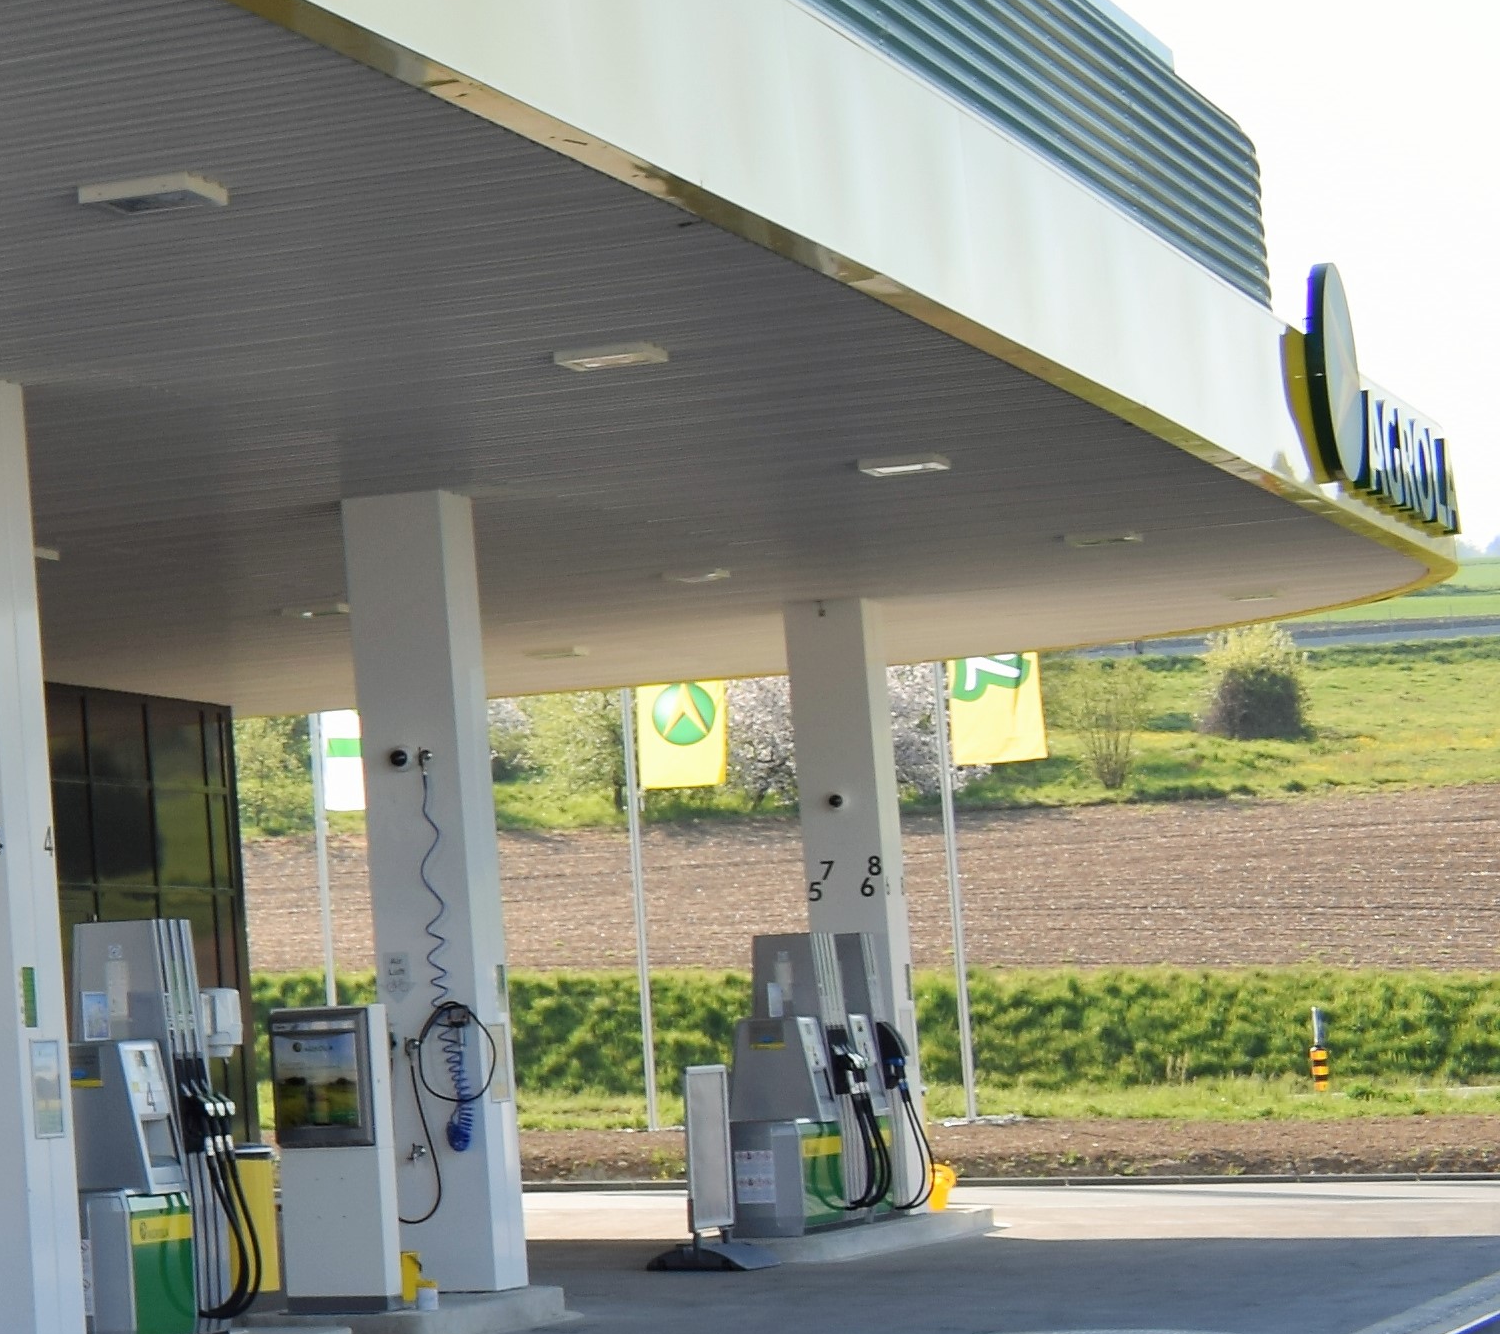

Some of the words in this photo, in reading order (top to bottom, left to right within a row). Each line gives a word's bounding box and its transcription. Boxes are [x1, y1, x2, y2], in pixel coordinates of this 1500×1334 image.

[1360, 390, 1462, 535] AGROLA
[43, 826, 54, 857] 4
[820, 860, 835, 881] 7
[868, 855, 882, 876] 8
[808, 881, 823, 902] 5
[860, 877, 875, 897] 6
